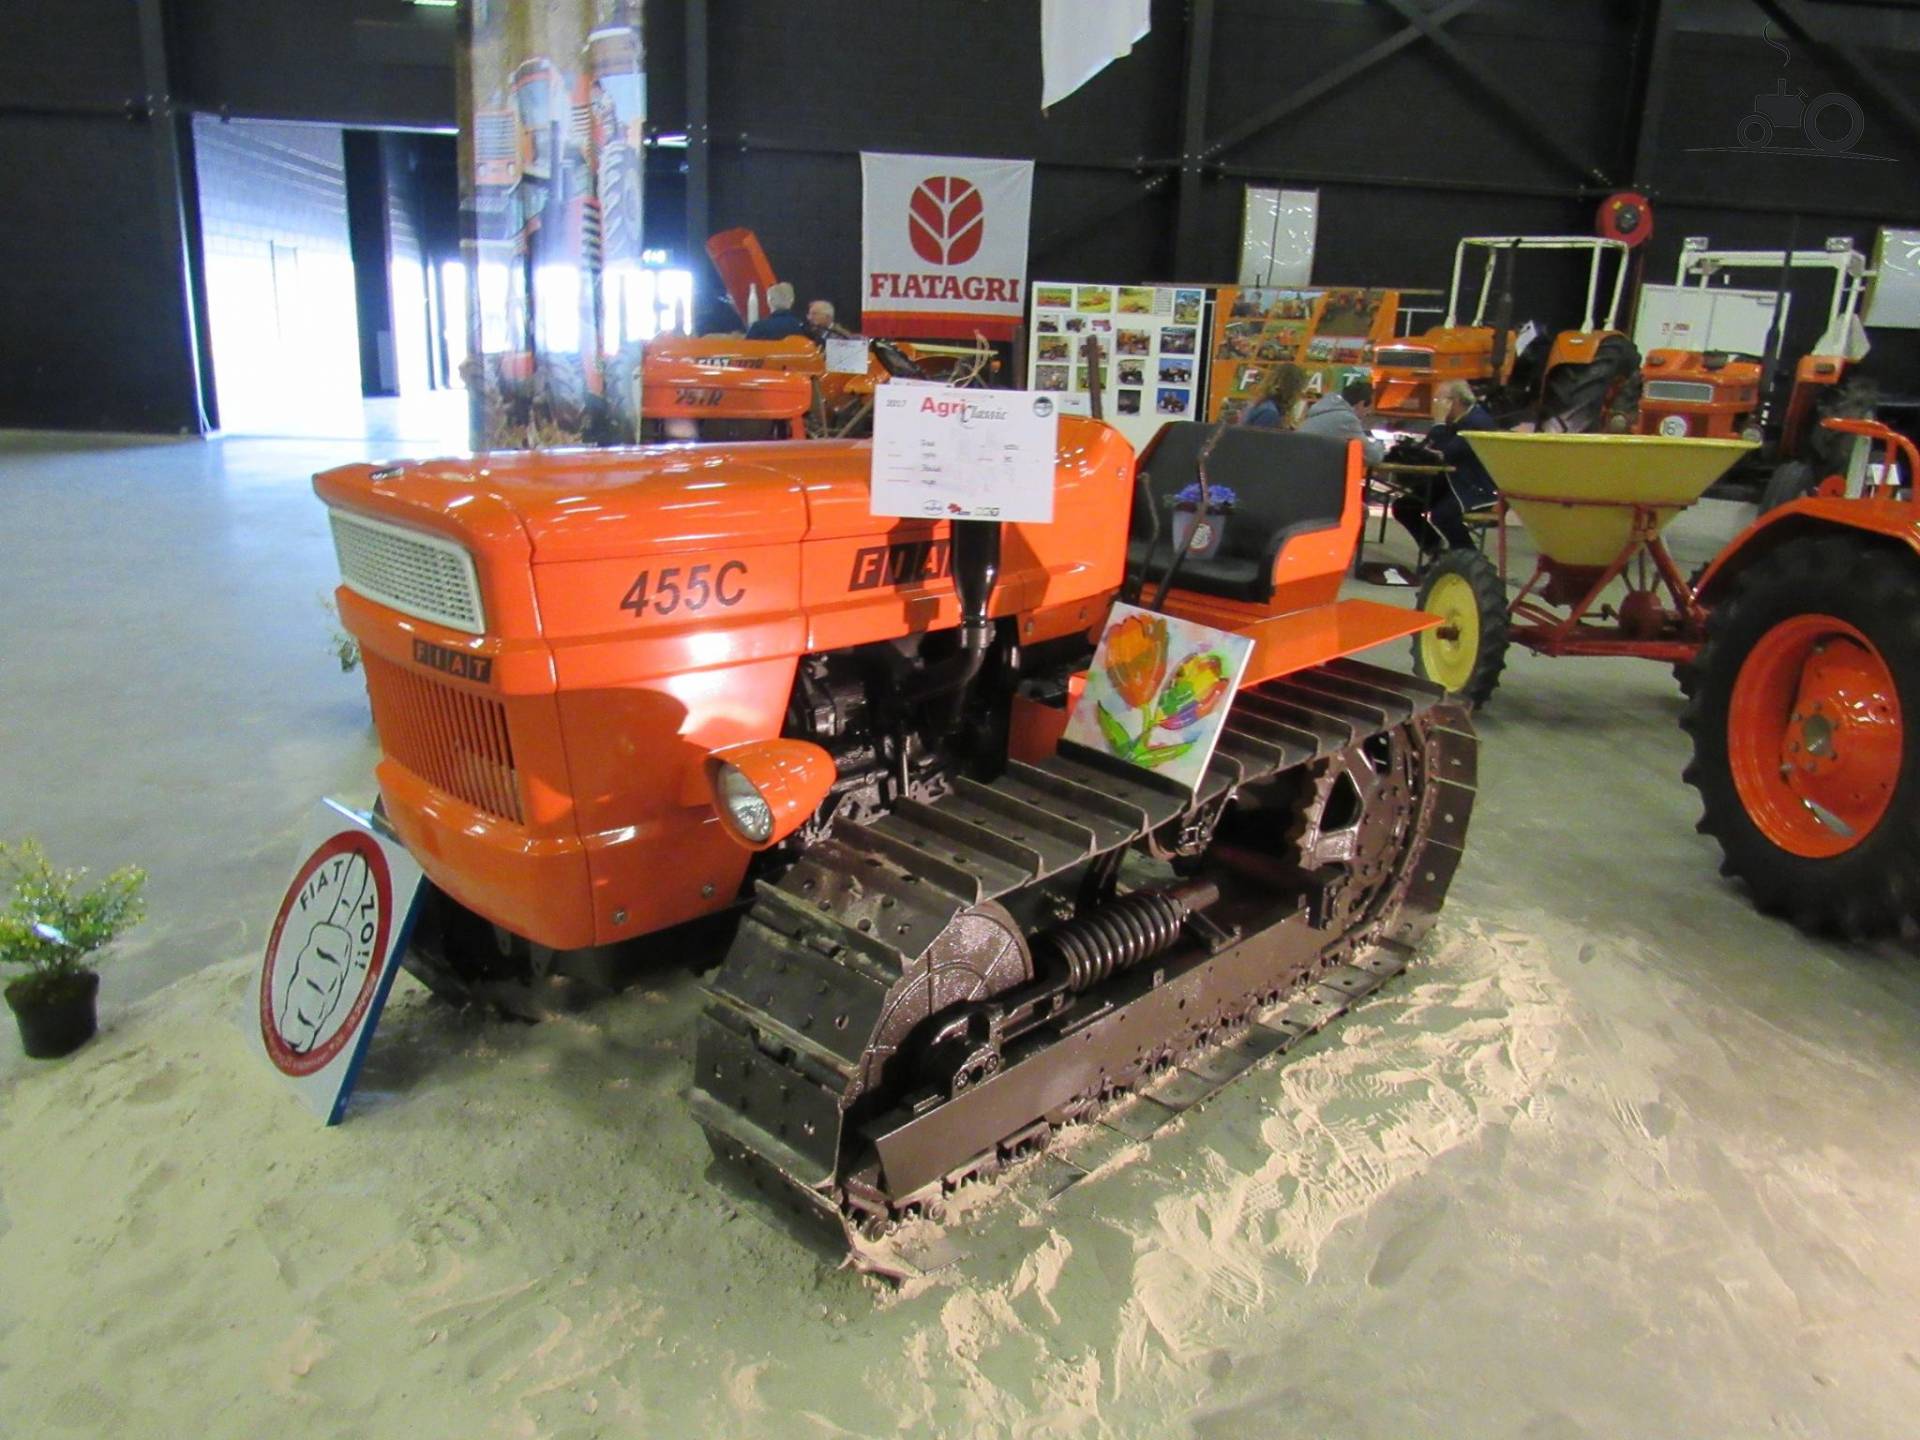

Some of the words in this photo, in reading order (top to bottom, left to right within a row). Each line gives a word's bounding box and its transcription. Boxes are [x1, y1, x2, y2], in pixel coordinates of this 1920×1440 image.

[870, 273, 1020, 303] FIATAGRI
[1239, 368, 1361, 394] FAT
[852, 543, 945, 589] FIA
[619, 559, 748, 618] 455C
[415, 640, 489, 680] FIAT
[300, 860, 344, 911] FIAT
